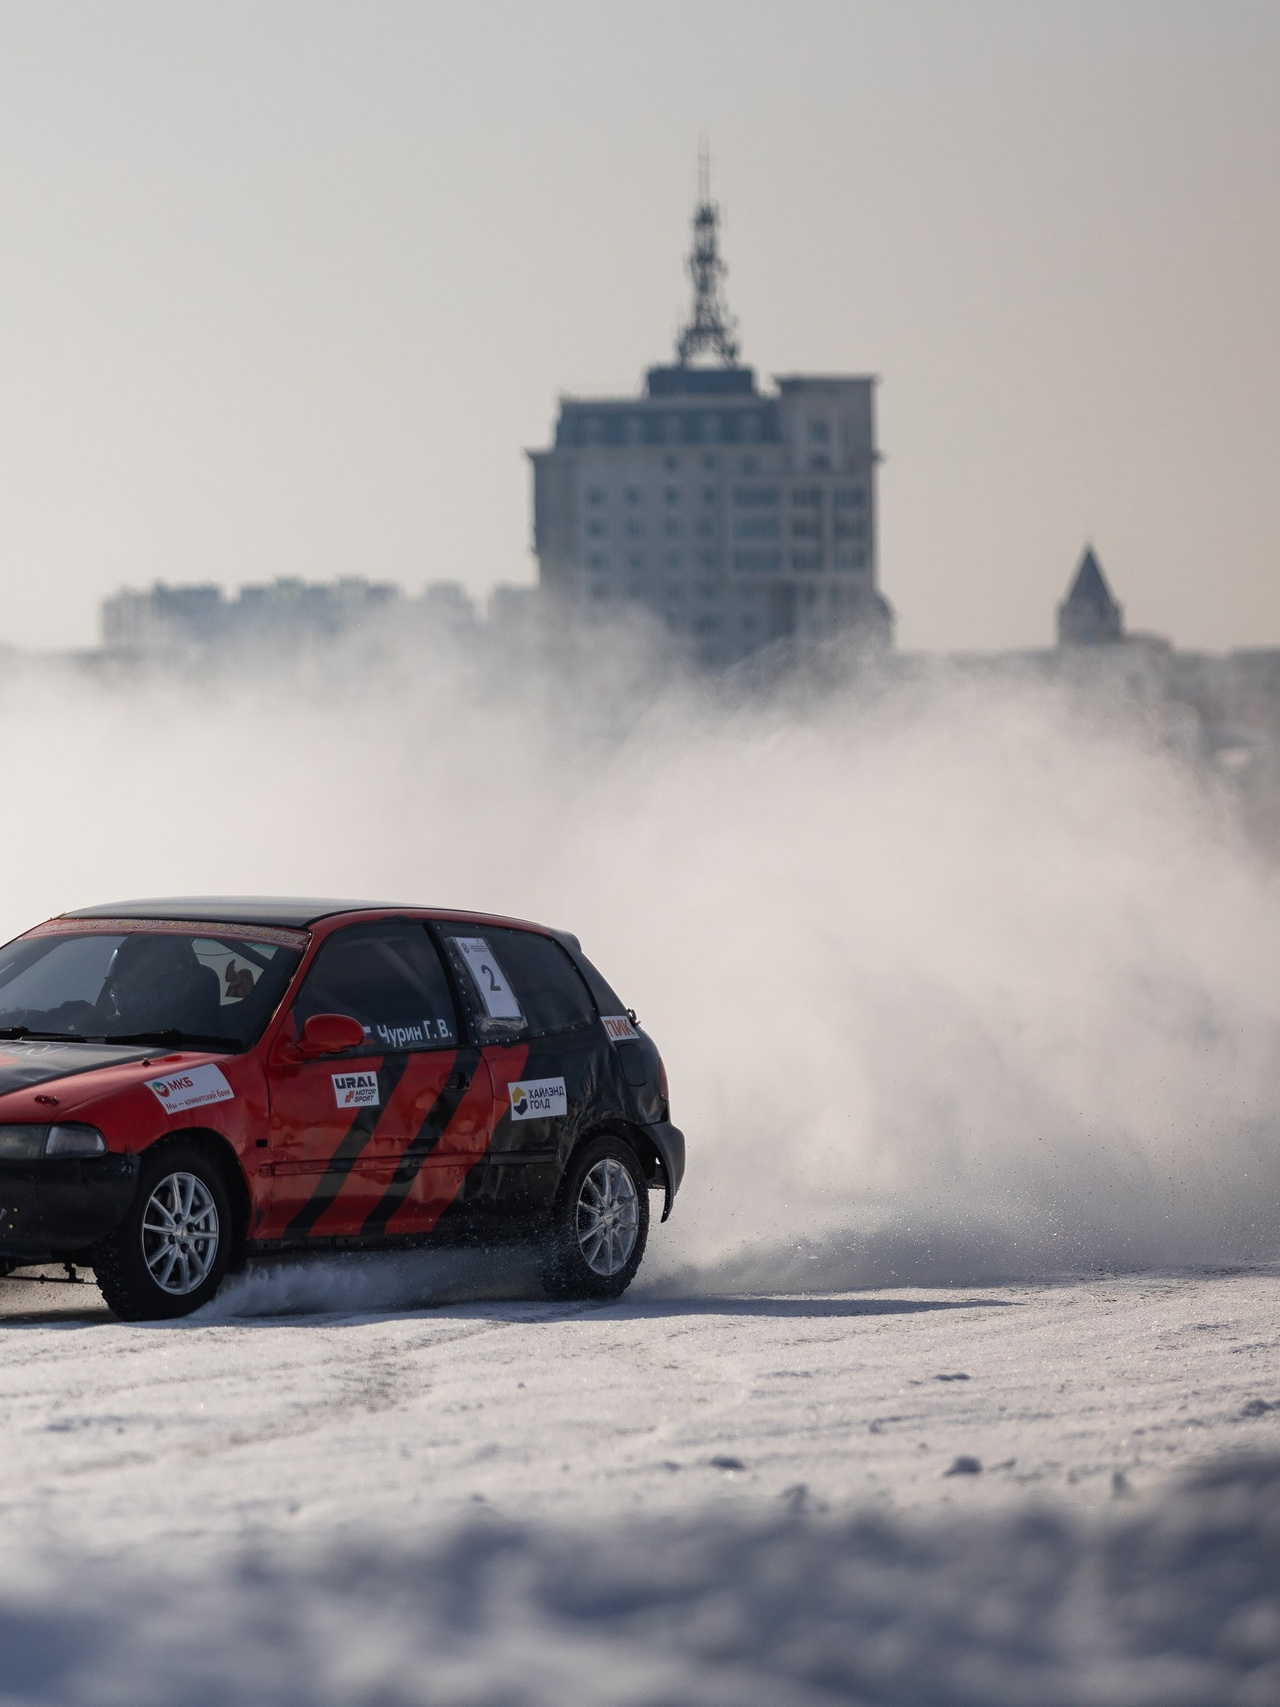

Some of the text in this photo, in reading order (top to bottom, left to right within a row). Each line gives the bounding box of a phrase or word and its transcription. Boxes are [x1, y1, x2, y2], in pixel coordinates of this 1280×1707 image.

[481, 964, 502, 991] 2
[604, 1019, 636, 1037] ПИК
[377, 1024, 423, 1048] Чурин
[167, 1076, 194, 1091] МКБ
[334, 1076, 376, 1089] URAL
[165, 1102, 178, 1110] Мы
[184, 1091, 216, 1106] клиентский
[216, 1089, 232, 1098] банк
[354, 1095, 375, 1103] SPORT
[528, 1086, 565, 1099] ХАЙЛЭНД
[530, 1098, 551, 1110] ГОЛД
